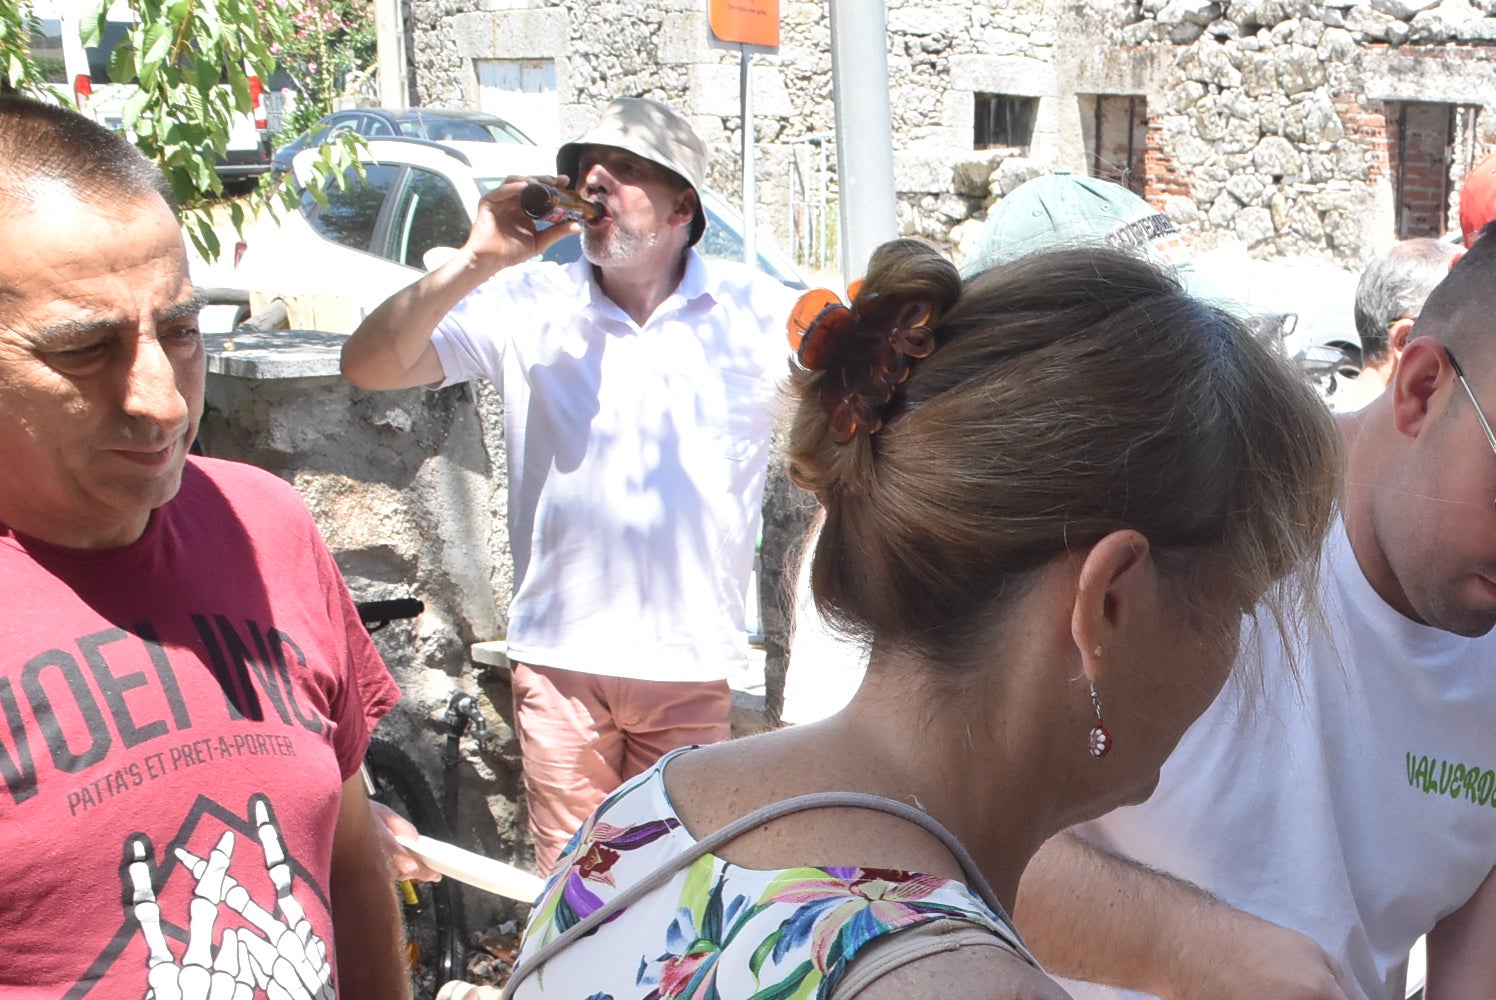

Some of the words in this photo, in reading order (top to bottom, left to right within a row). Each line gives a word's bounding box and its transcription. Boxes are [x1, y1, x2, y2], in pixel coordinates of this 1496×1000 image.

[67, 762, 144, 817] PATTA'S
[144, 752, 168, 780] ET
[168, 733, 297, 771] PRET-A-PORTER
